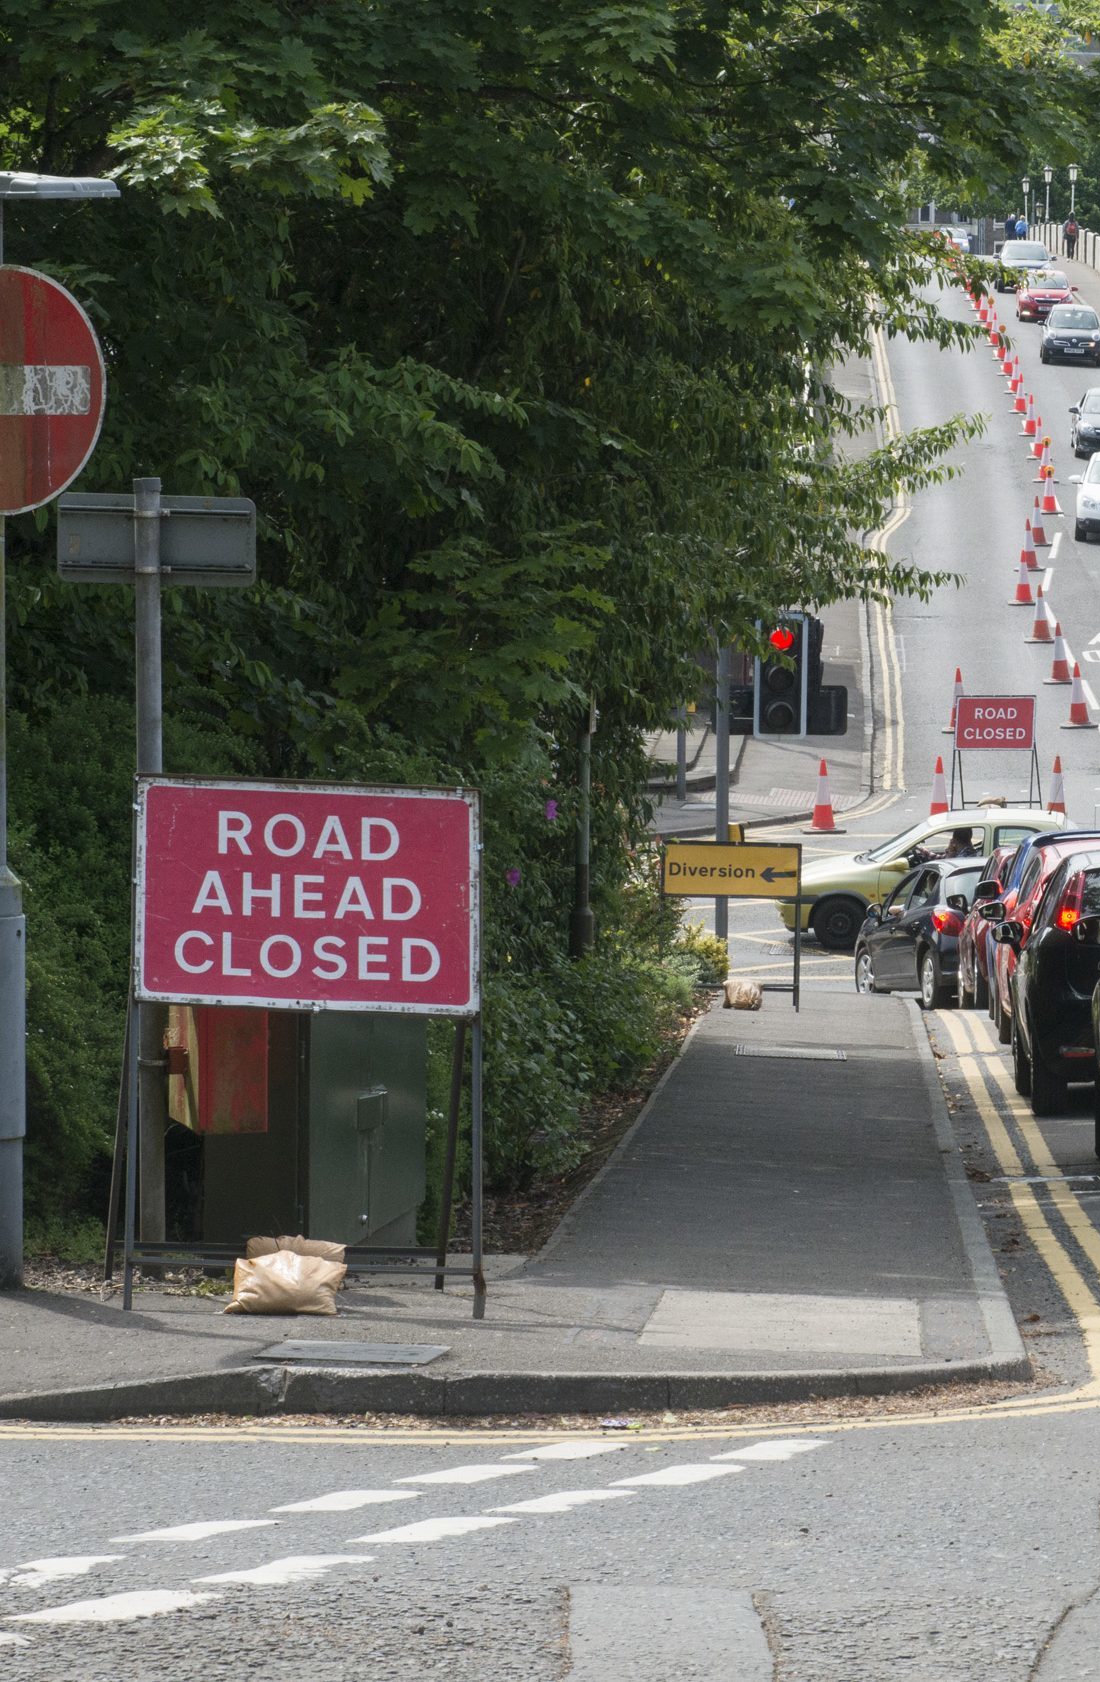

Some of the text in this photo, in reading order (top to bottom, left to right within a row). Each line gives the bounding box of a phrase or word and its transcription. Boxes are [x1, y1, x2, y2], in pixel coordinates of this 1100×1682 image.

[974, 707, 1017, 720] ROAD
[963, 727, 1026, 740] CLOSED
[218, 810, 400, 861] ROAD
[668, 862, 755, 878] Diversion
[192, 870, 422, 921] AHEAD
[174, 930, 441, 982] CLOSED
